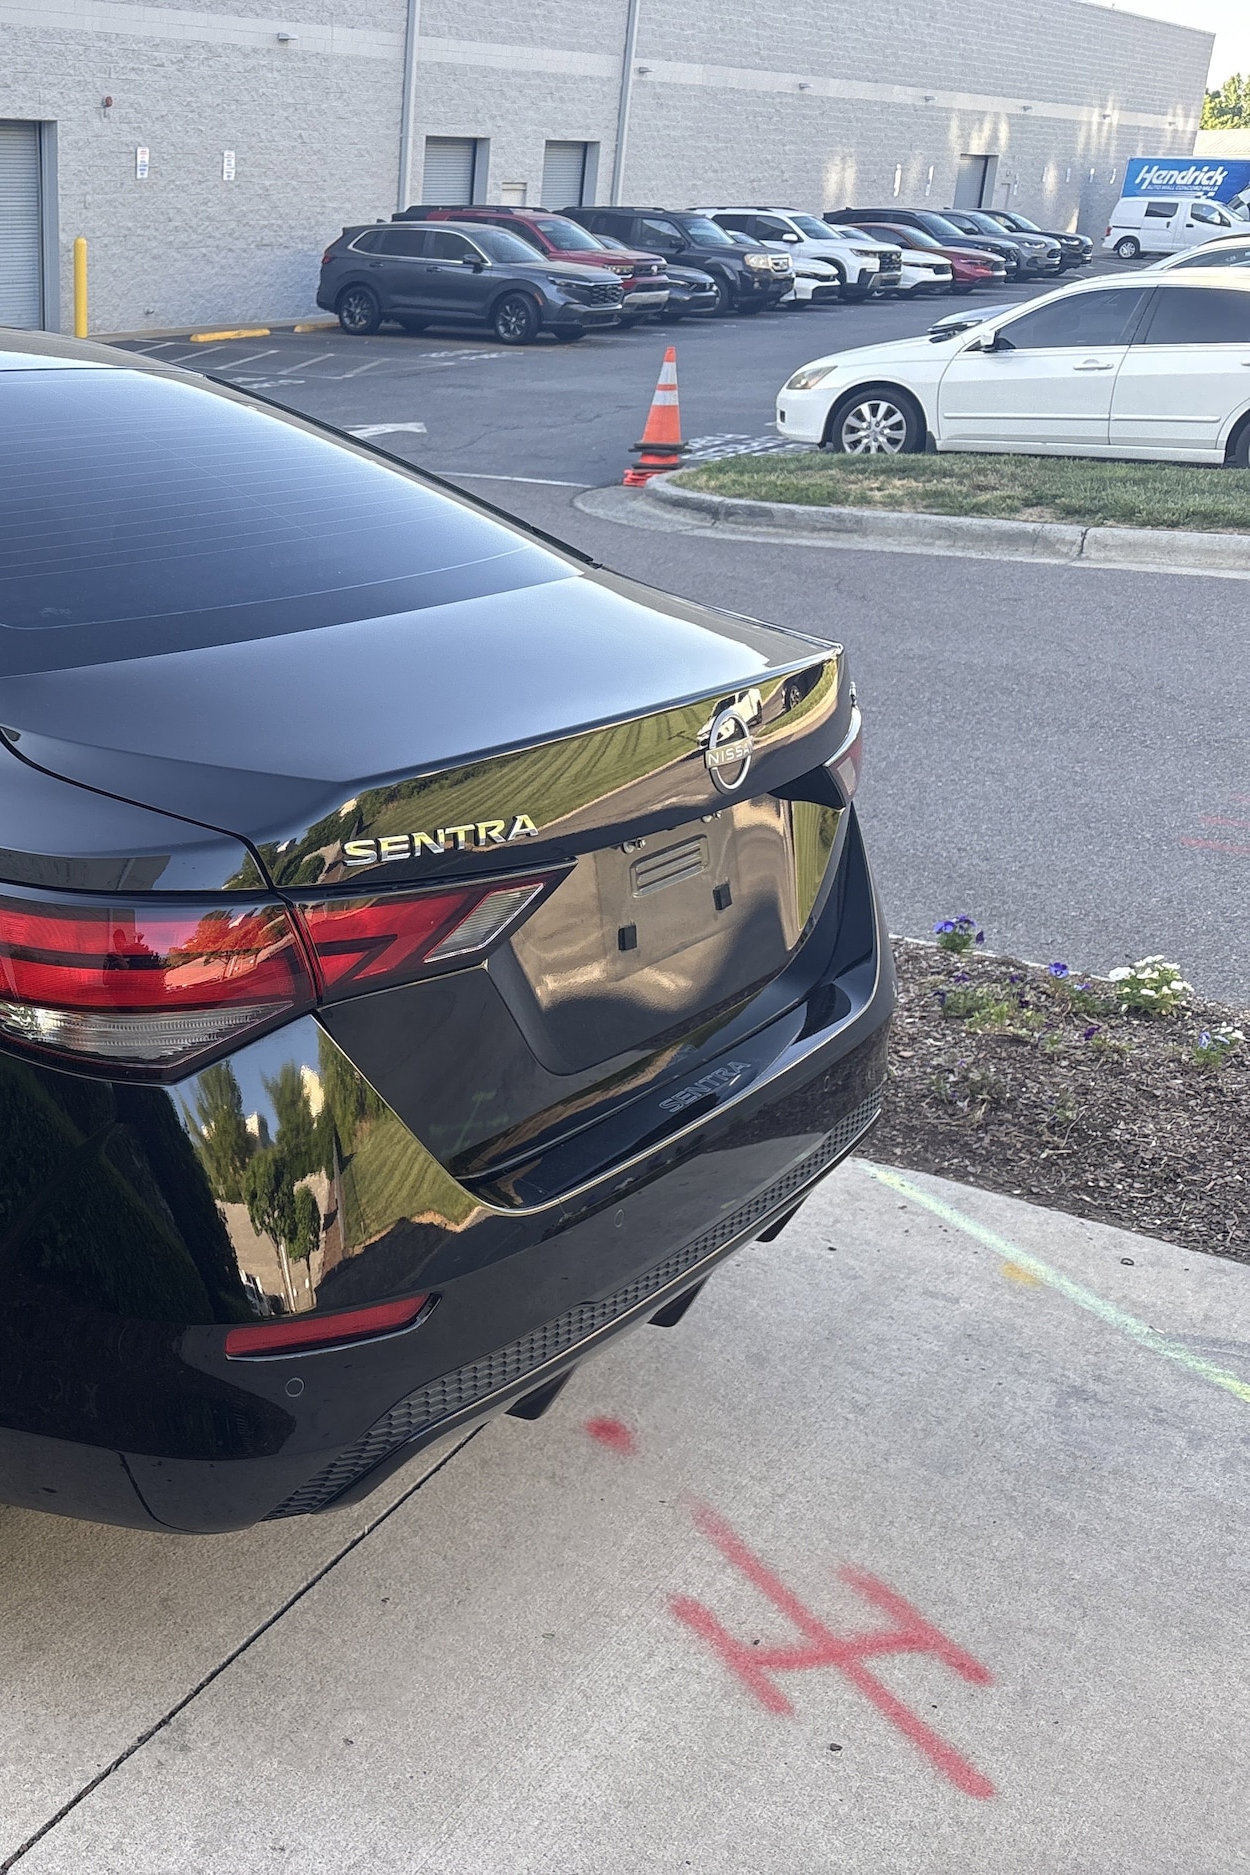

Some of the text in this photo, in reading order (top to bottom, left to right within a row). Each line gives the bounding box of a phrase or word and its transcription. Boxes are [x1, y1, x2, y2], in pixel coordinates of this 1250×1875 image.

[1134, 164, 1229, 190] Hendrick
[341, 813, 539, 868] SENTRA
[658, 1060, 752, 1113] SENTRA
